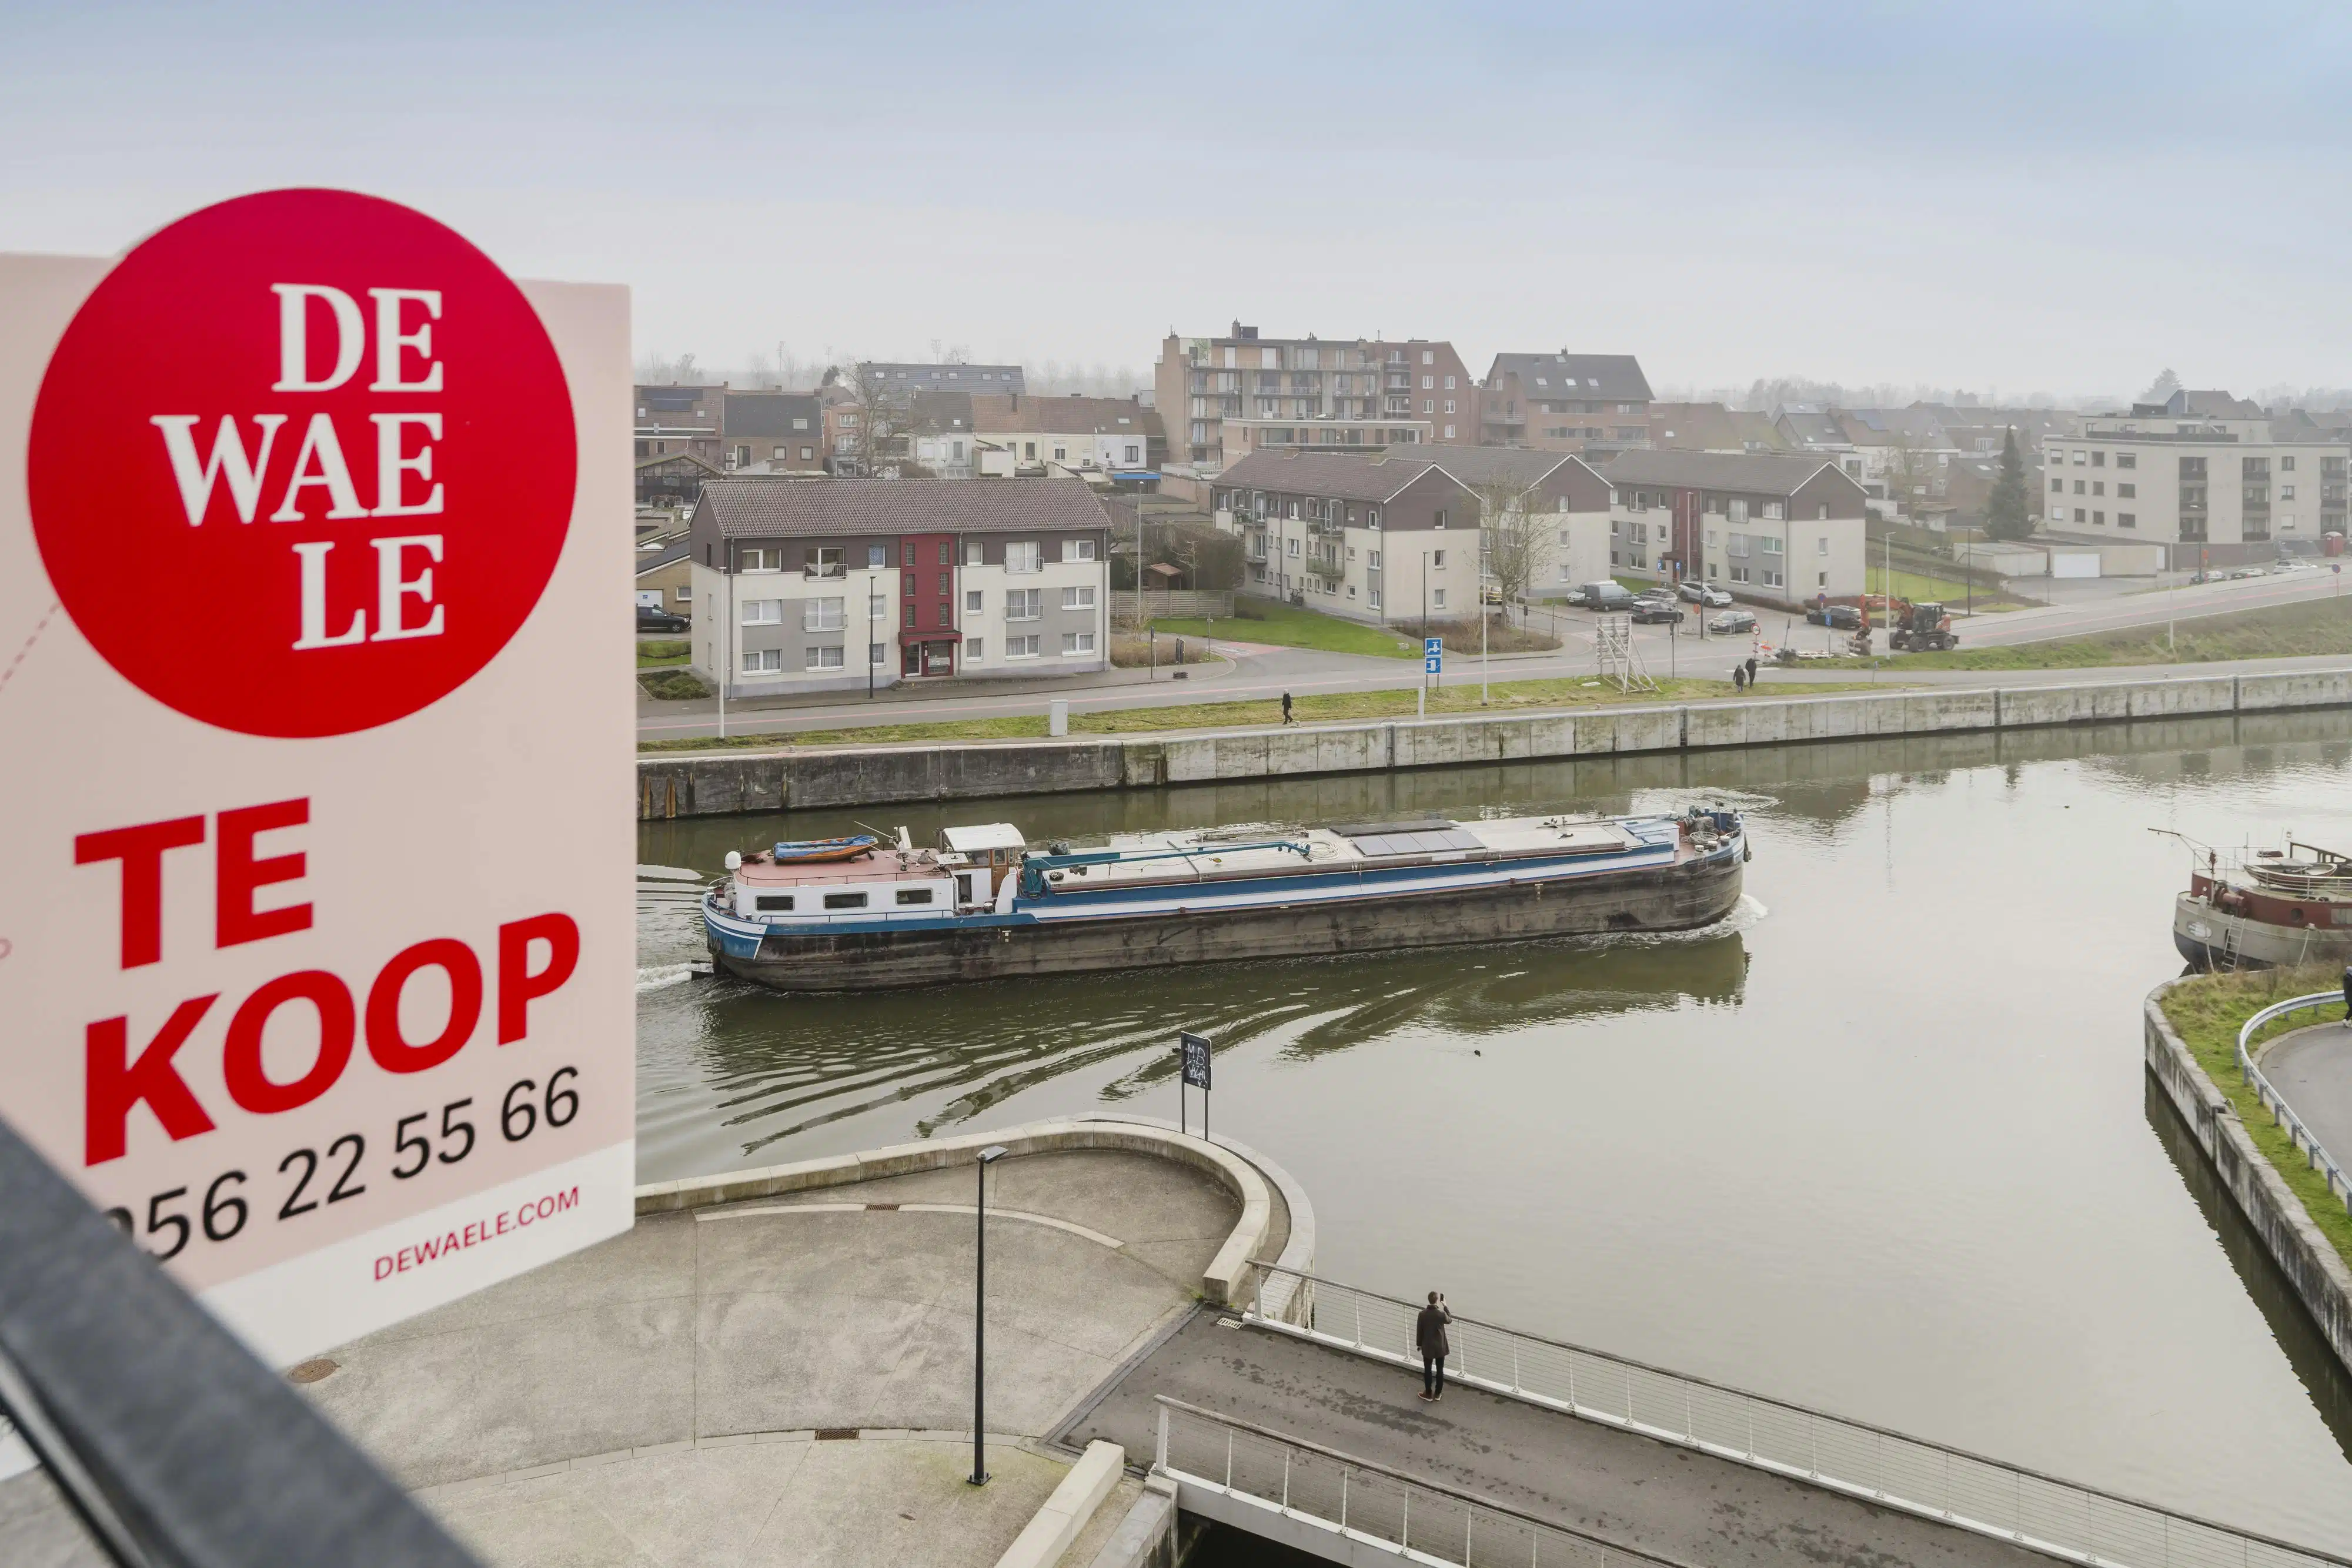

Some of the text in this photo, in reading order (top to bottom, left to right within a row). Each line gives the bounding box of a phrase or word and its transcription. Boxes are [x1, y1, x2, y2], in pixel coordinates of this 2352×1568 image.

[271, 283, 444, 393] DE
[150, 412, 445, 527] WAE
[292, 534, 445, 651] LE
[74, 797, 314, 971] TE
[84, 912, 581, 1168] KOOP
[278, 1133, 366, 1221] 22
[392, 1097, 475, 1180] 55
[501, 1065, 579, 1142] 66
[375, 1186, 579, 1282] DEWAELE.COM
